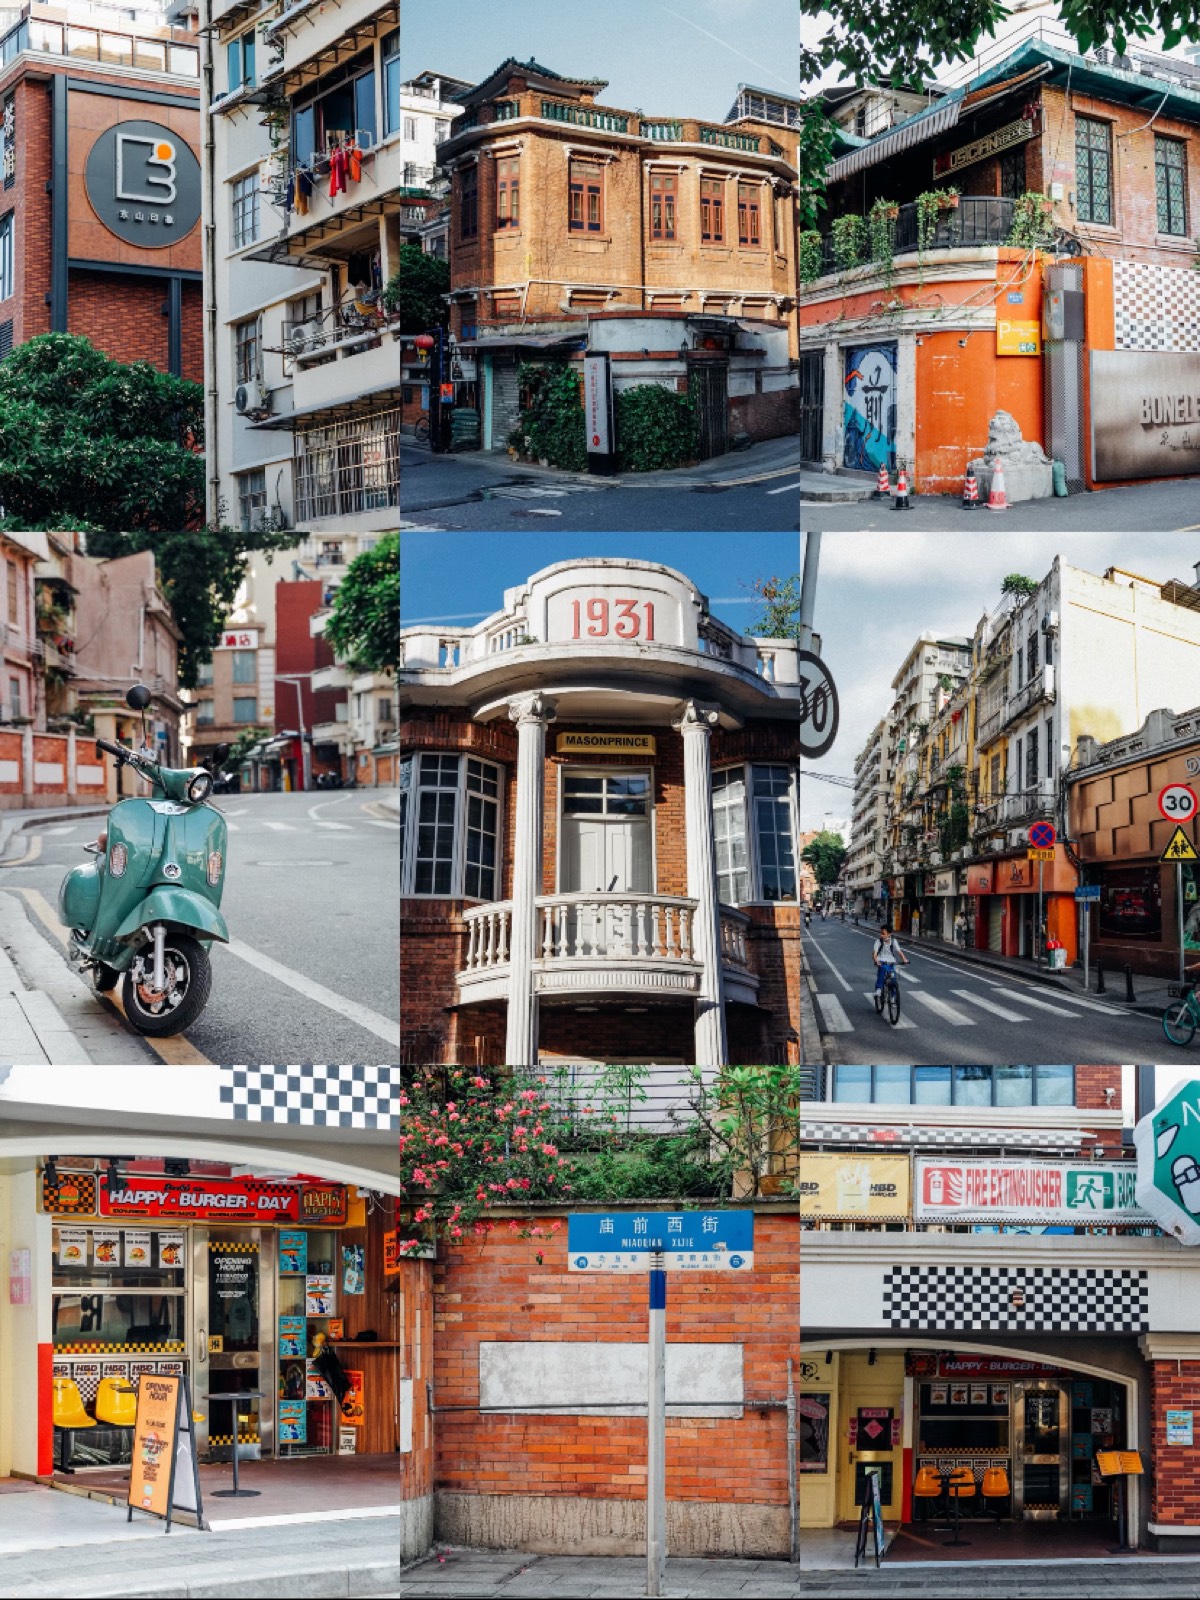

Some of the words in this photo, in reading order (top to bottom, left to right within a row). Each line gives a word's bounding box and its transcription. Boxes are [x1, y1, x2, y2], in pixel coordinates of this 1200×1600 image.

[571, 598, 655, 641] 1931
[566, 735, 648, 747] MASONPRINCE
[1165, 796, 1192, 811] 30
[870, 1183, 896, 1191] HBD
[966, 1168, 988, 1206] FIRE
[990, 1168, 1062, 1208] EXTINGUISHER
[109, 1190, 169, 1205] HAPPY
[179, 1192, 247, 1208] BURGER
[257, 1195, 291, 1209] DAY
[599, 1216, 719, 1234] 庙前西街
[621, 1238, 662, 1248] MIAOQIAN
[946, 1362, 981, 1370] HAPPY
[990, 1362, 1034, 1370] BURGER
